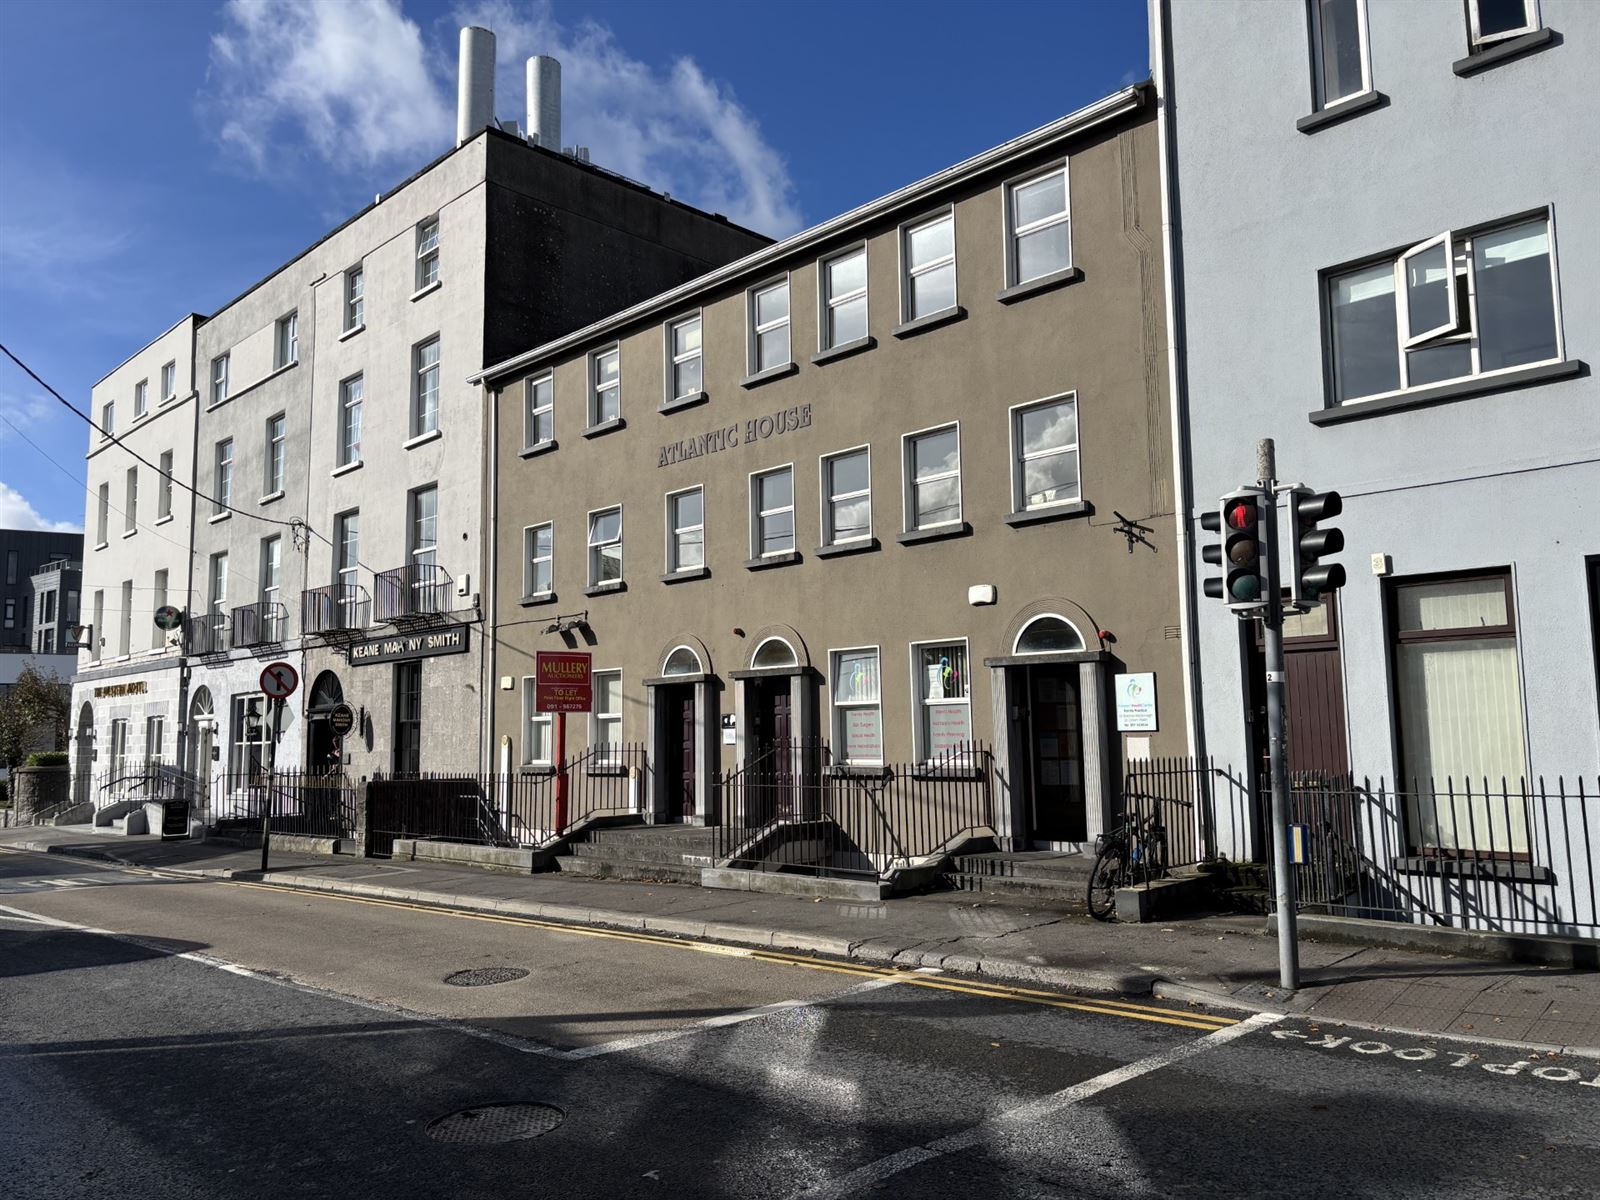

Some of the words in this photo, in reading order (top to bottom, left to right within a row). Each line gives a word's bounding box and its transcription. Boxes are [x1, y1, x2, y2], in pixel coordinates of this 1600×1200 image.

[657, 423, 739, 468] ATLANTIC
[743, 403, 812, 444] HOUSE
[352, 643, 380, 659] KEANE
[384, 637, 422, 655] MAHNY
[427, 632, 460, 649] SMITH
[541, 662, 588, 673] MULLERY
[1267, 673, 1273, 682] 2
[1304, 1034, 1472, 1067] LOOK
